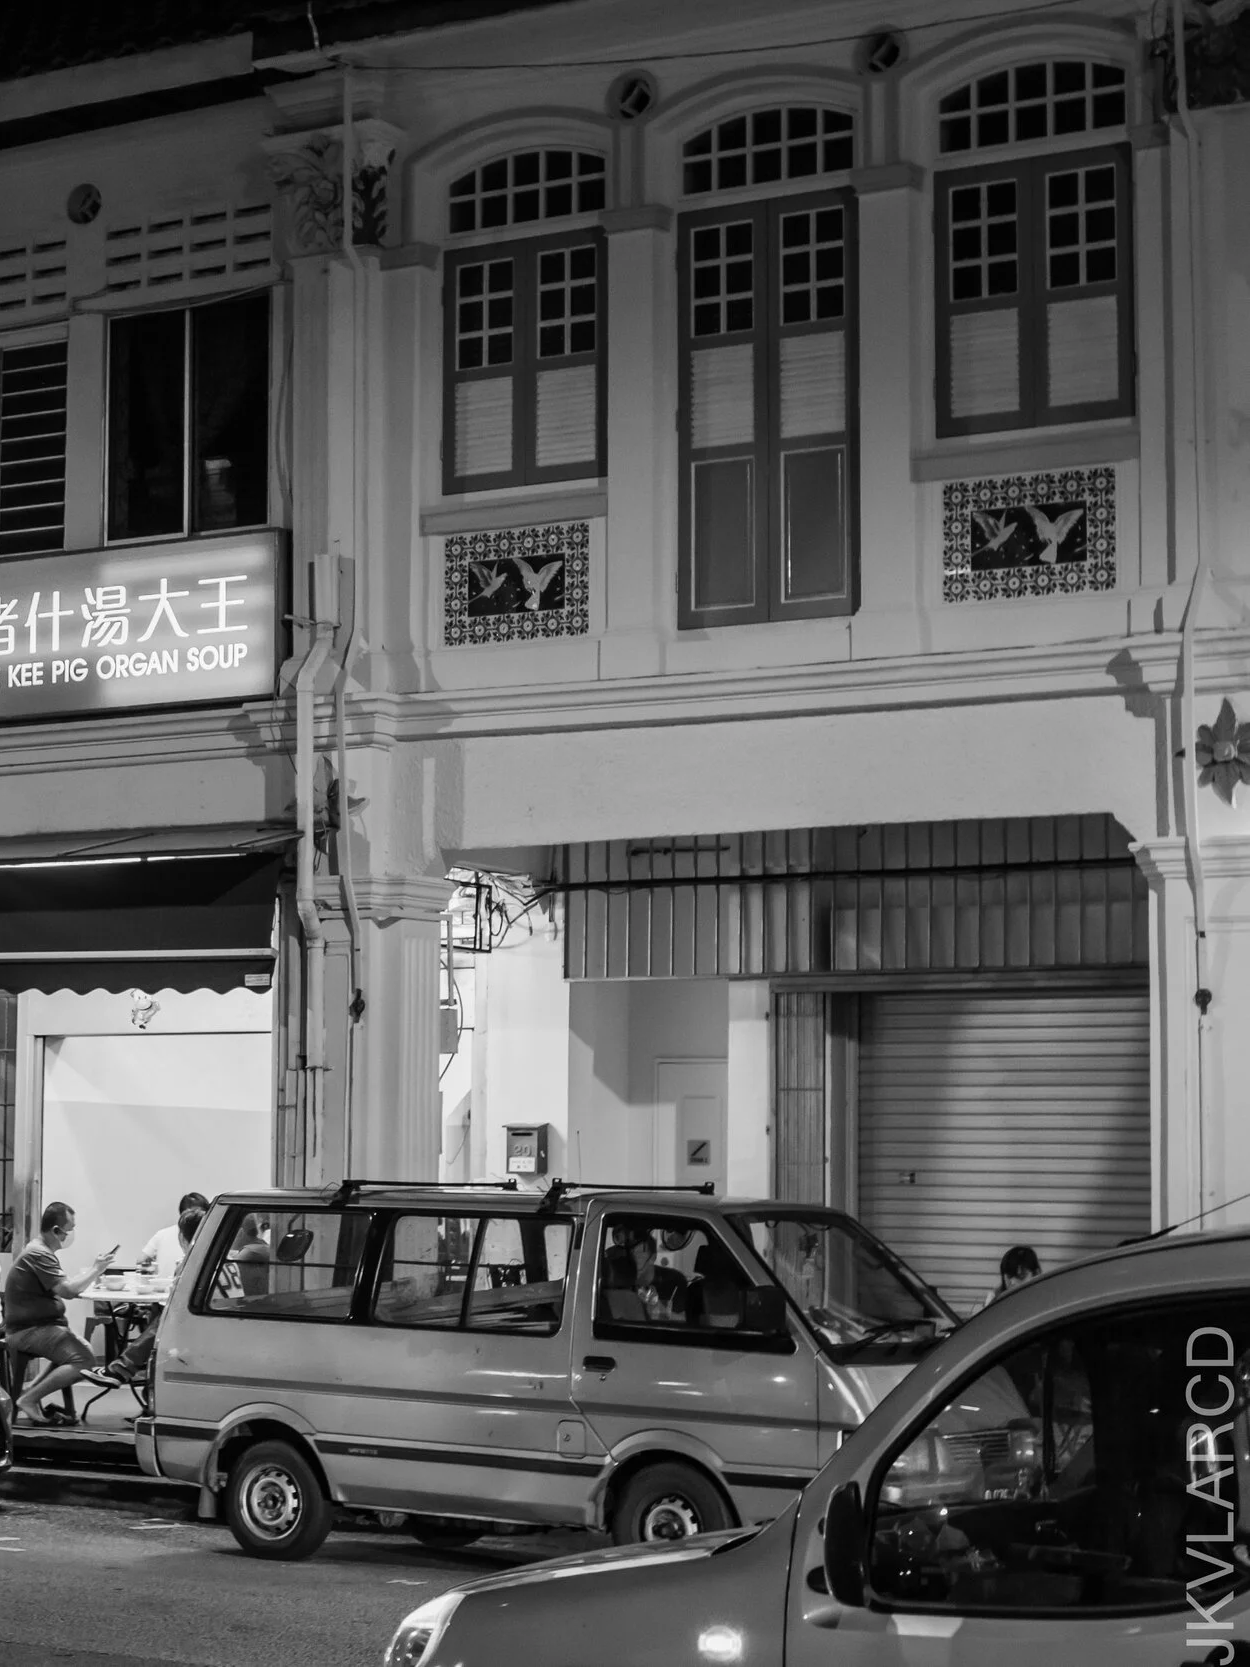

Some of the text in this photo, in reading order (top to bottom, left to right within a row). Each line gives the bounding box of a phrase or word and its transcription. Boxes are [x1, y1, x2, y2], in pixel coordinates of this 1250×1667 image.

[8, 662, 44, 687] KEE
[51, 657, 89, 684] PIG
[96, 649, 179, 680] ORGAN
[186, 643, 248, 672] SOUP
